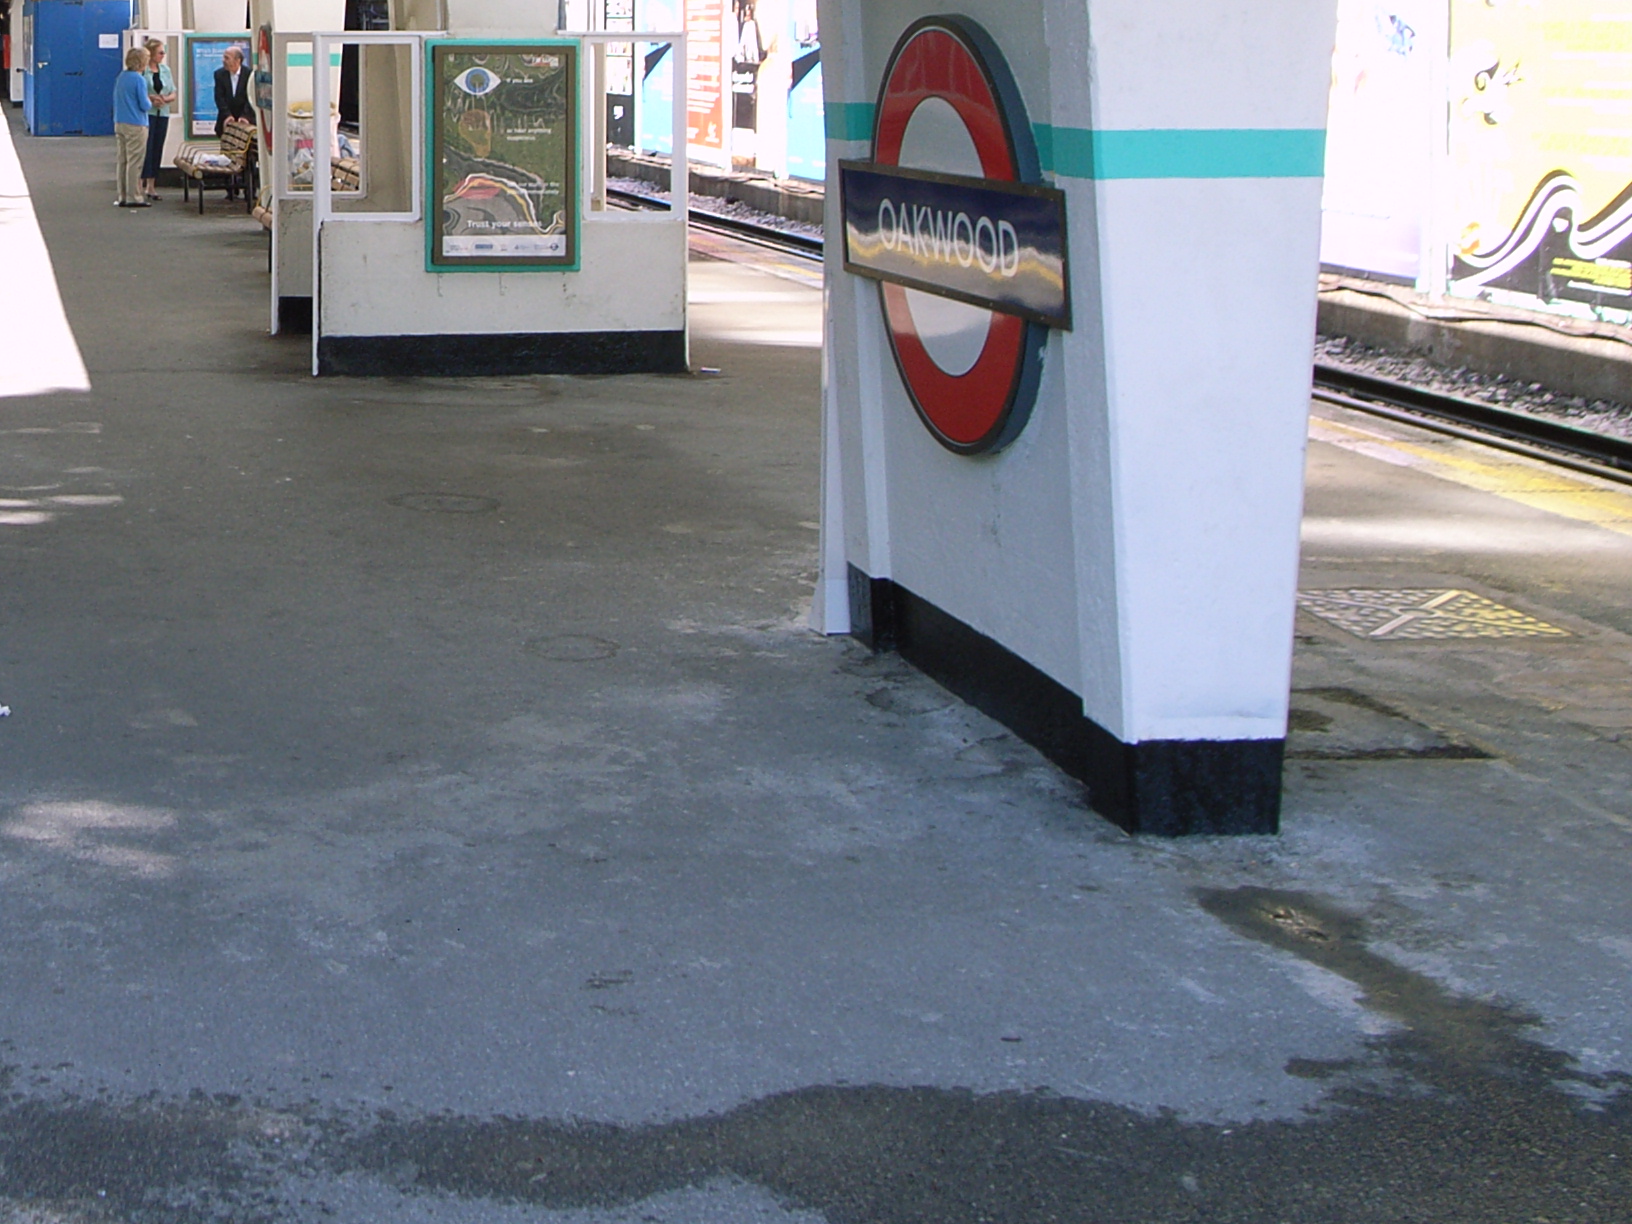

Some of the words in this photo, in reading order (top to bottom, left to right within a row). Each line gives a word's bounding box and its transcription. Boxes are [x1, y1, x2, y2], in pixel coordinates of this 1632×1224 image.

[467, 219, 489, 229] Trust
[491, 221, 511, 230] your
[878, 198, 1019, 278] OAKWOOD
